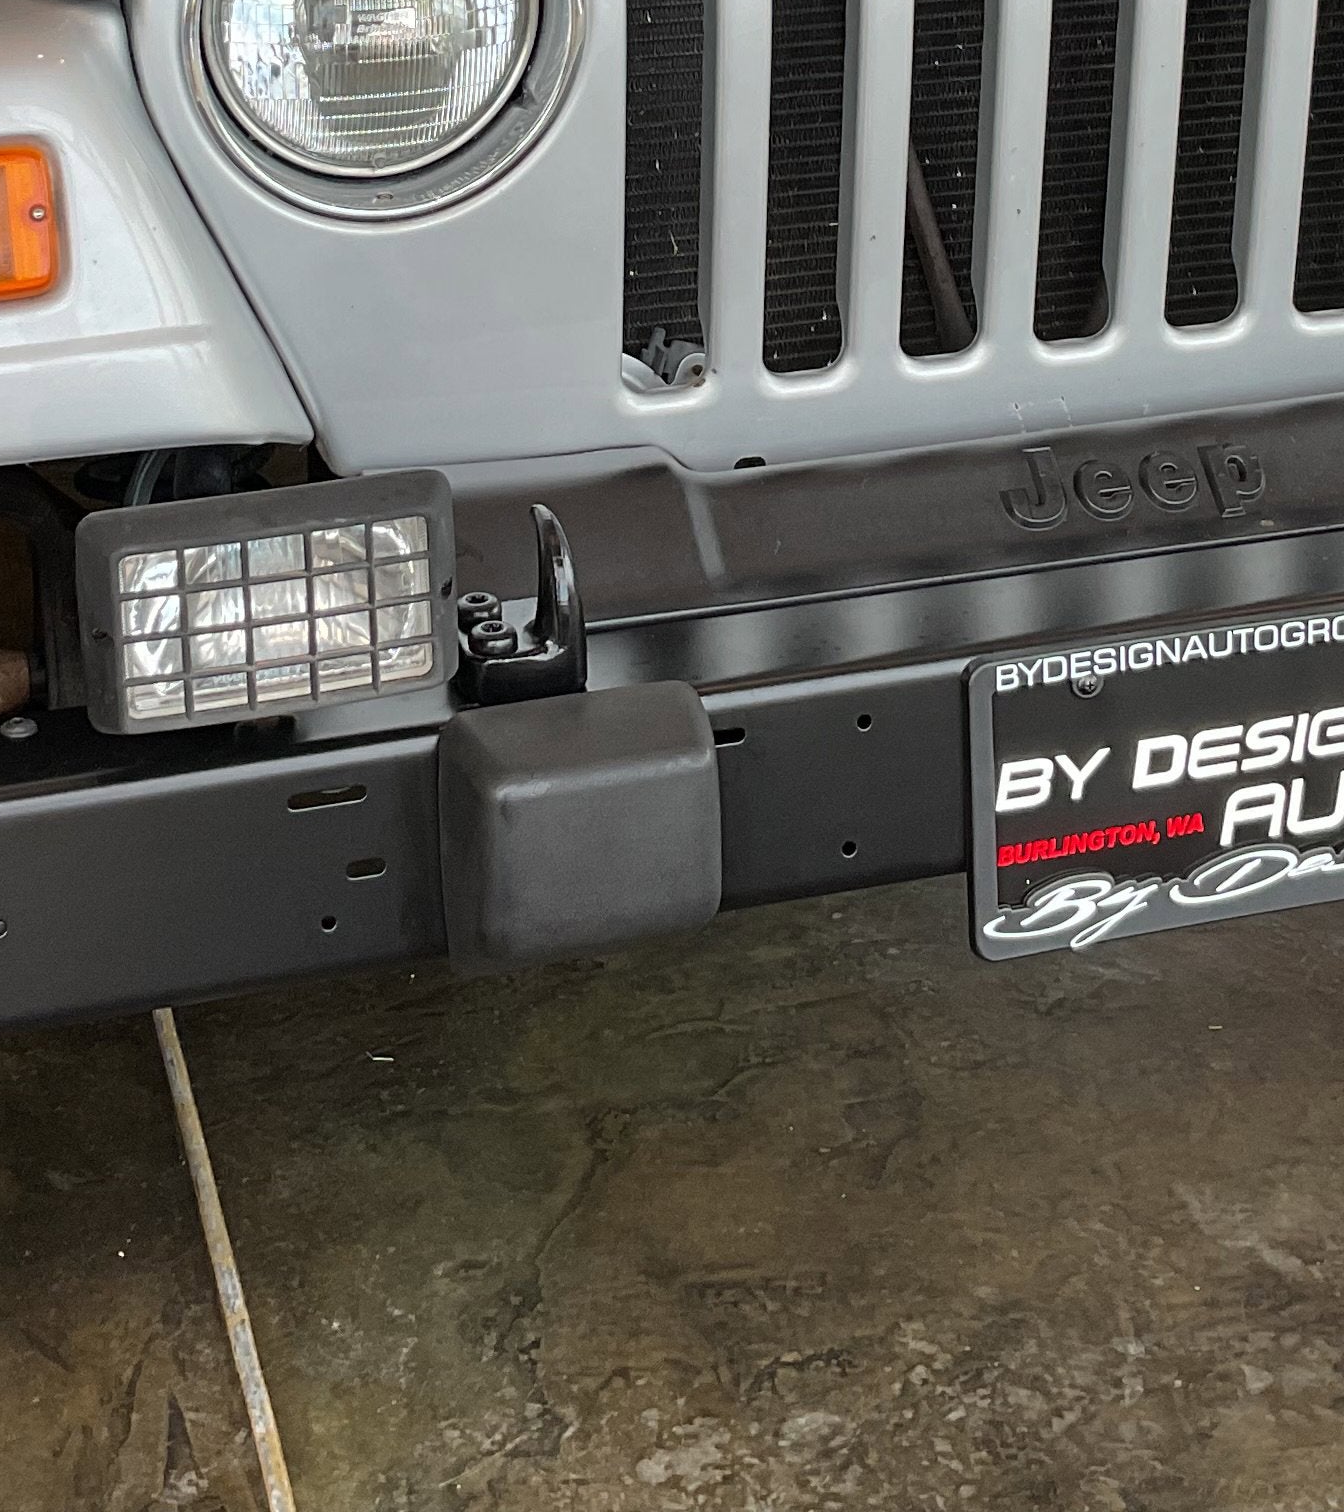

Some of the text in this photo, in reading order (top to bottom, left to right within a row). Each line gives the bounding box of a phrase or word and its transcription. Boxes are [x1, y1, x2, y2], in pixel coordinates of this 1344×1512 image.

[999, 443, 1267, 531] Jeep
[994, 746, 1111, 813] BY
[996, 811, 1205, 867] BURLINGTON, WA
[982, 878, 1160, 951] By
